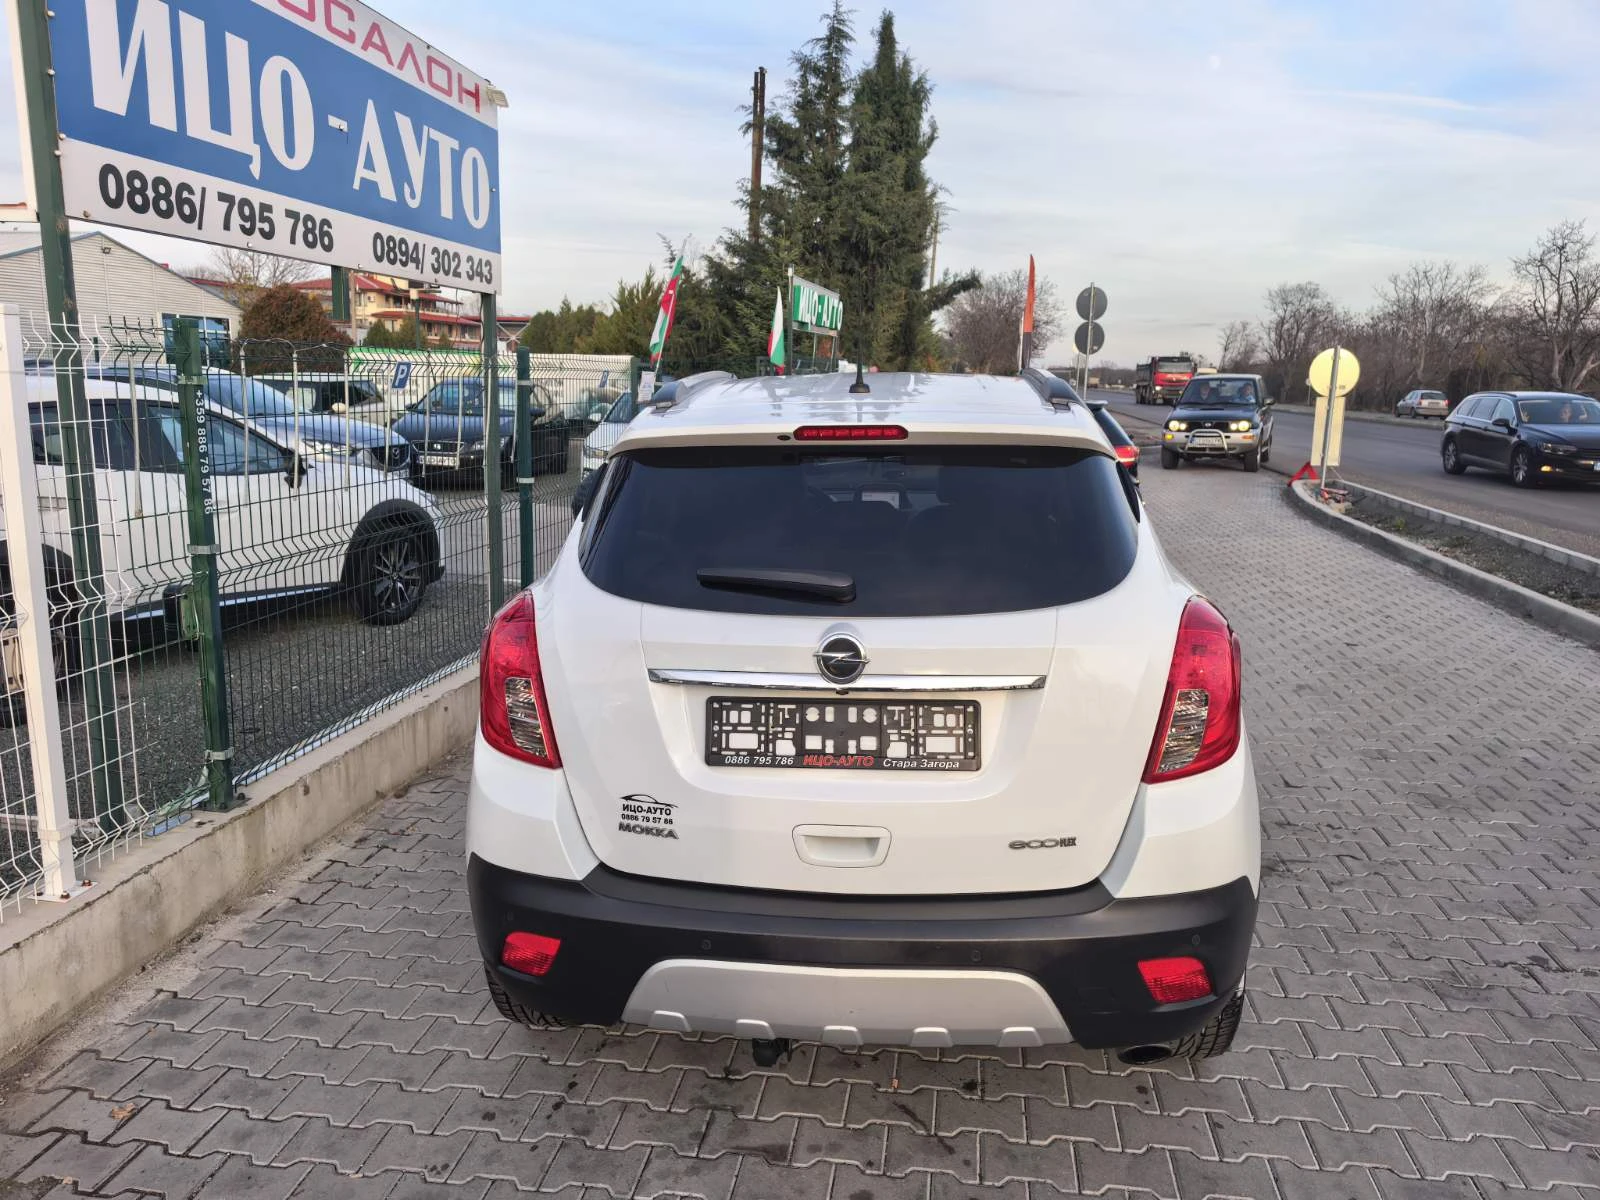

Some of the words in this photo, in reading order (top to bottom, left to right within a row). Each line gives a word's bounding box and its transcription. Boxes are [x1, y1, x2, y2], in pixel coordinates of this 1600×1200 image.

[98, 162, 207, 232] 0886/
[217, 191, 277, 242] 795
[284, 209, 335, 254] 786
[372, 231, 426, 276] 0894/
[430, 245, 463, 280] 302
[466, 256, 495, 287] 343
[194, 389, 207, 424] +359
[197, 427, 208, 454] 886
[199, 456, 210, 475] 79
[201, 478, 212, 493] 57
[203, 498, 214, 515] 86
[724, 755, 750, 766] 0886
[753, 756, 772, 766] 795
[774, 756, 794, 766] 786
[803, 755, 876, 768] ИЦО-АУТО
[882, 758, 918, 769] Стара
[920, 758, 960, 769] Загора
[622, 803, 672, 816] ИЦО-АУТО
[641, 815, 651, 823] 79
[652, 816, 662, 824] 57
